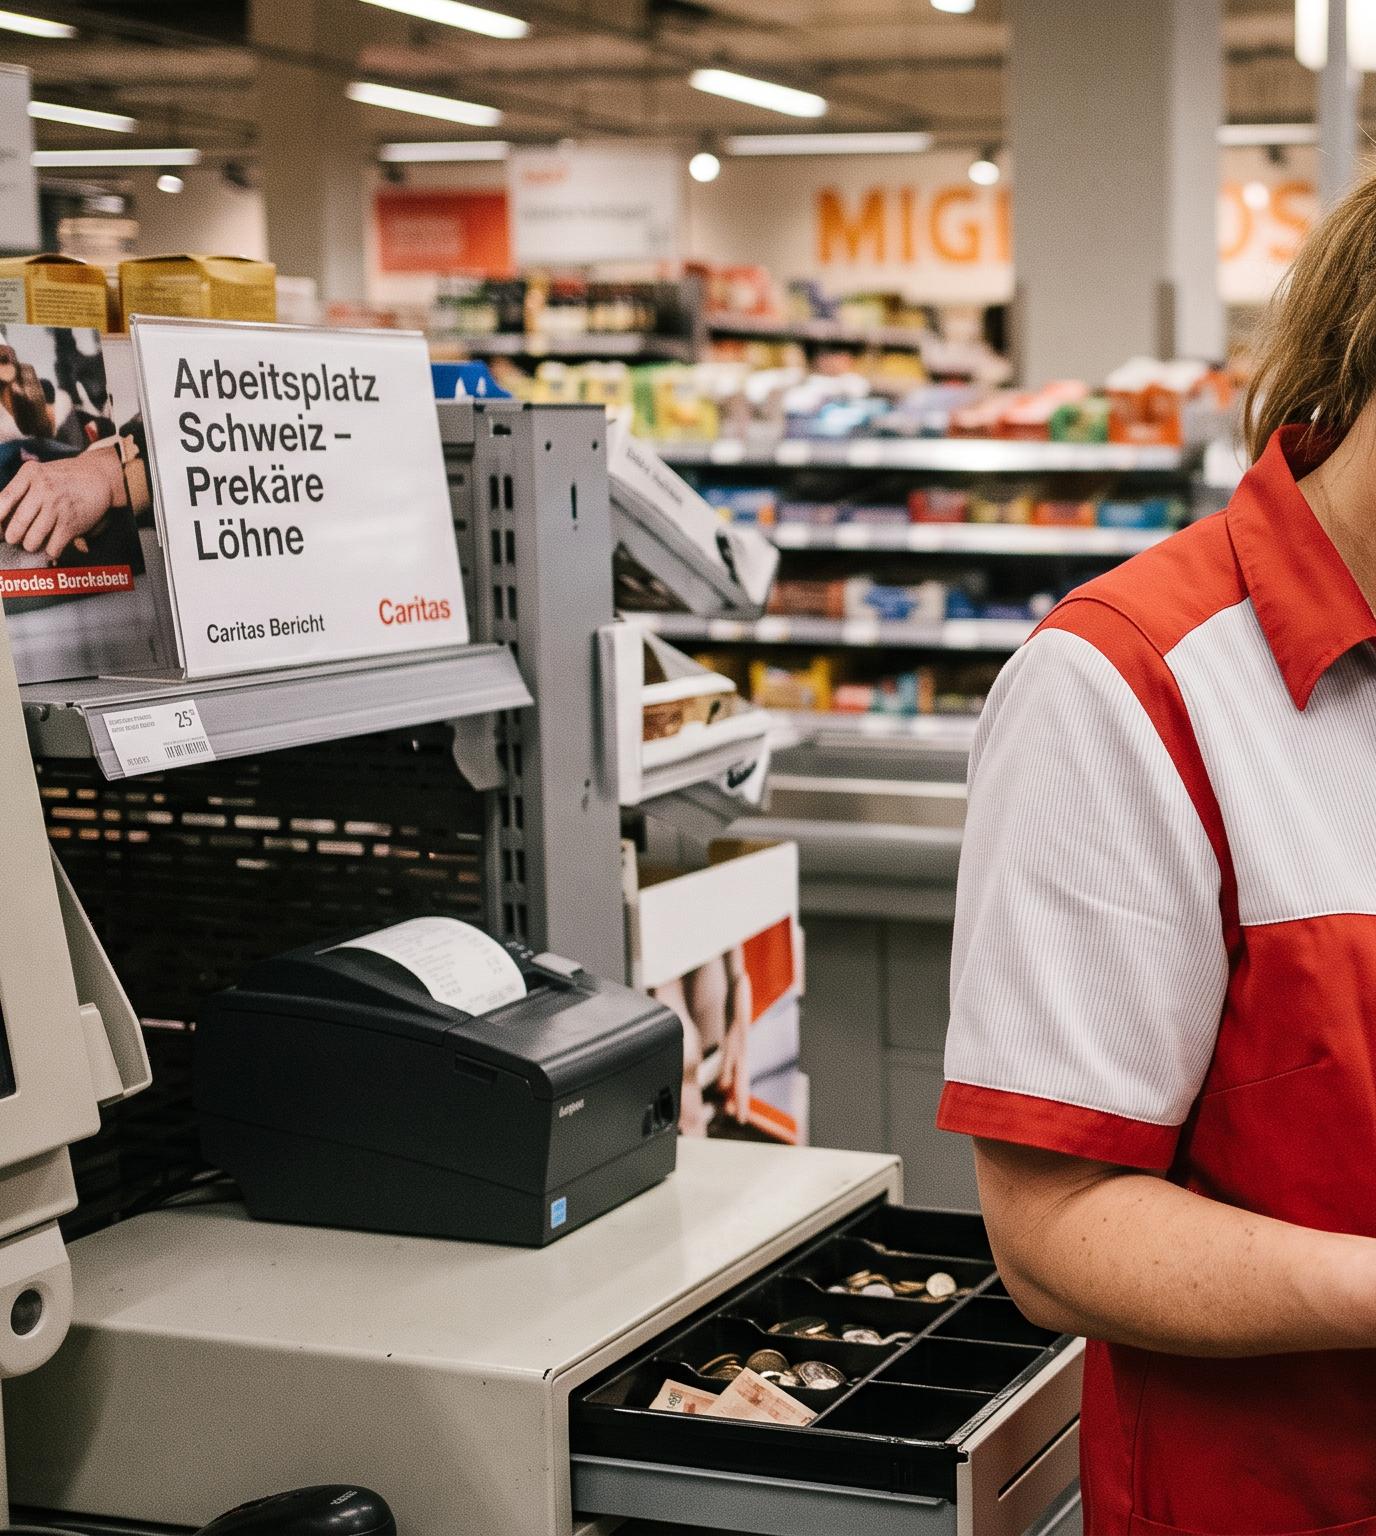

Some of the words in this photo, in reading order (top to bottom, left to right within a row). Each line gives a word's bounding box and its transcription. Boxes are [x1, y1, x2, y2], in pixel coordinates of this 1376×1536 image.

[174, 357, 380, 410] Arbeitsplatz
[178, 411, 327, 453] Schweiz
[186, 464, 324, 507] Prekäre
[193, 518, 304, 561] Löhne
[206, 621, 266, 644] Caritas
[270, 613, 326, 637] Bericht
[378, 595, 451, 626] Caritas
